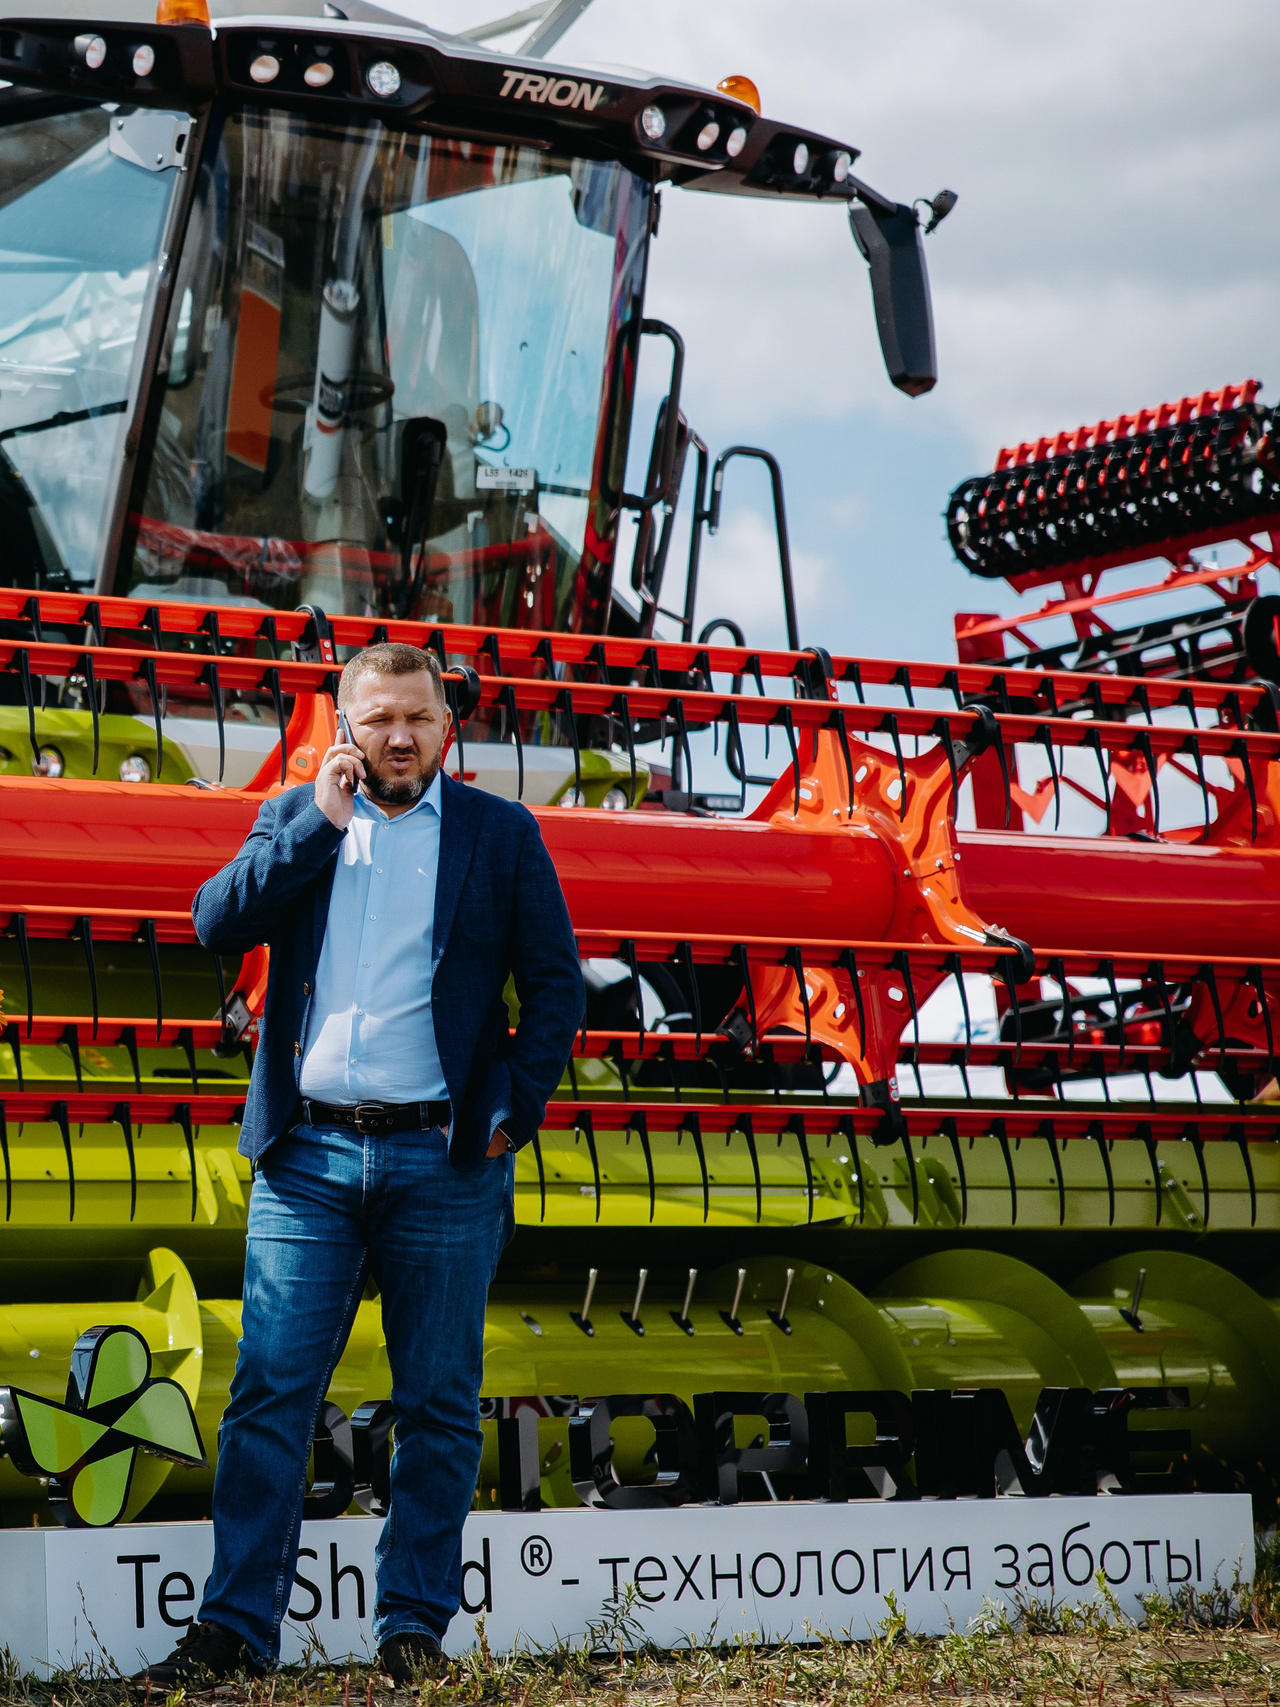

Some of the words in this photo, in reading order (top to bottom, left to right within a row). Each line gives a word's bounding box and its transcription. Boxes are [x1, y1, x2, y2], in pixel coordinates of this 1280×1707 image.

[500, 69, 604, 111] TRION
[598, 1545, 973, 1604] технология
[994, 1521, 1202, 1589] заботы
